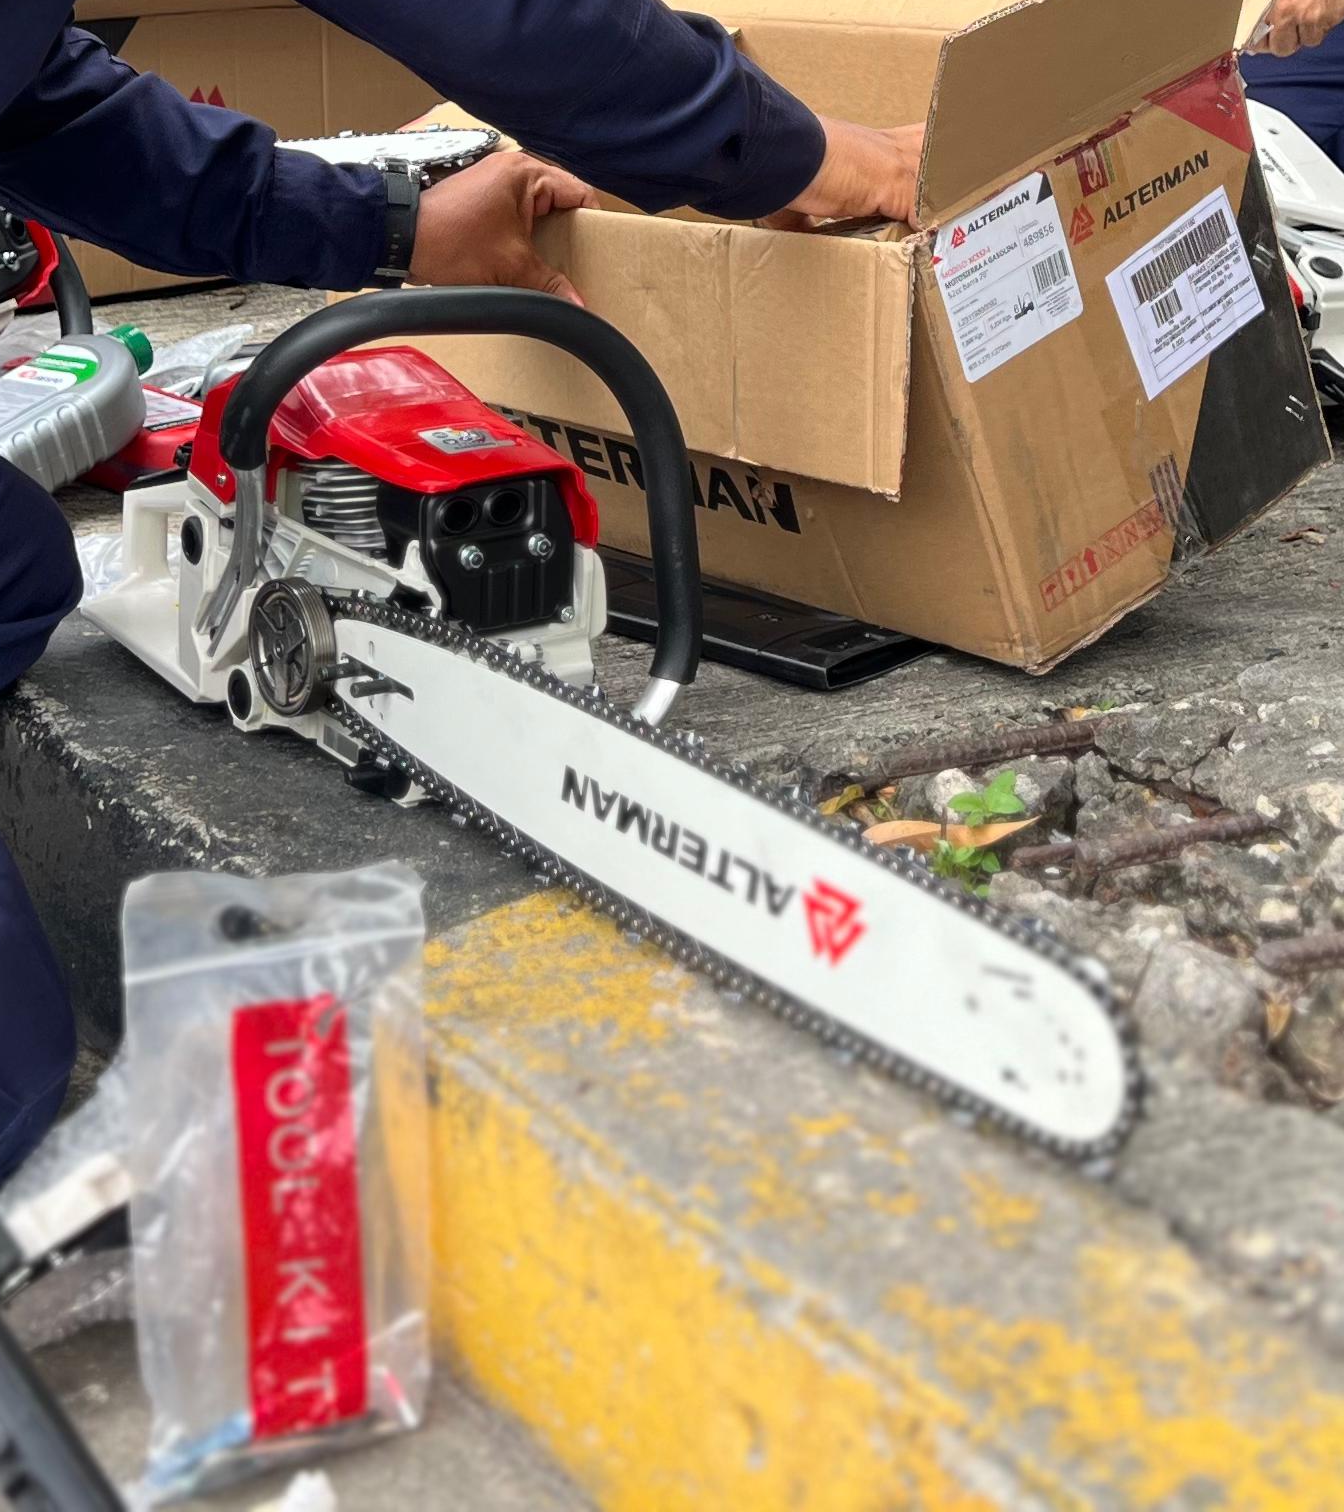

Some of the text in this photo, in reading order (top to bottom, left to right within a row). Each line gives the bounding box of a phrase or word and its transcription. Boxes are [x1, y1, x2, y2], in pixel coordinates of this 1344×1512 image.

[967, 190, 1029, 235] ALTERMAN
[1023, 221, 1055, 248] 489856
[1104, 150, 1209, 229] ALTERMAN
[502, 407, 801, 535] TERAN
[561, 764, 797, 916] ALTERMAN
[263, 1039, 337, 1406] TOOL KIT
